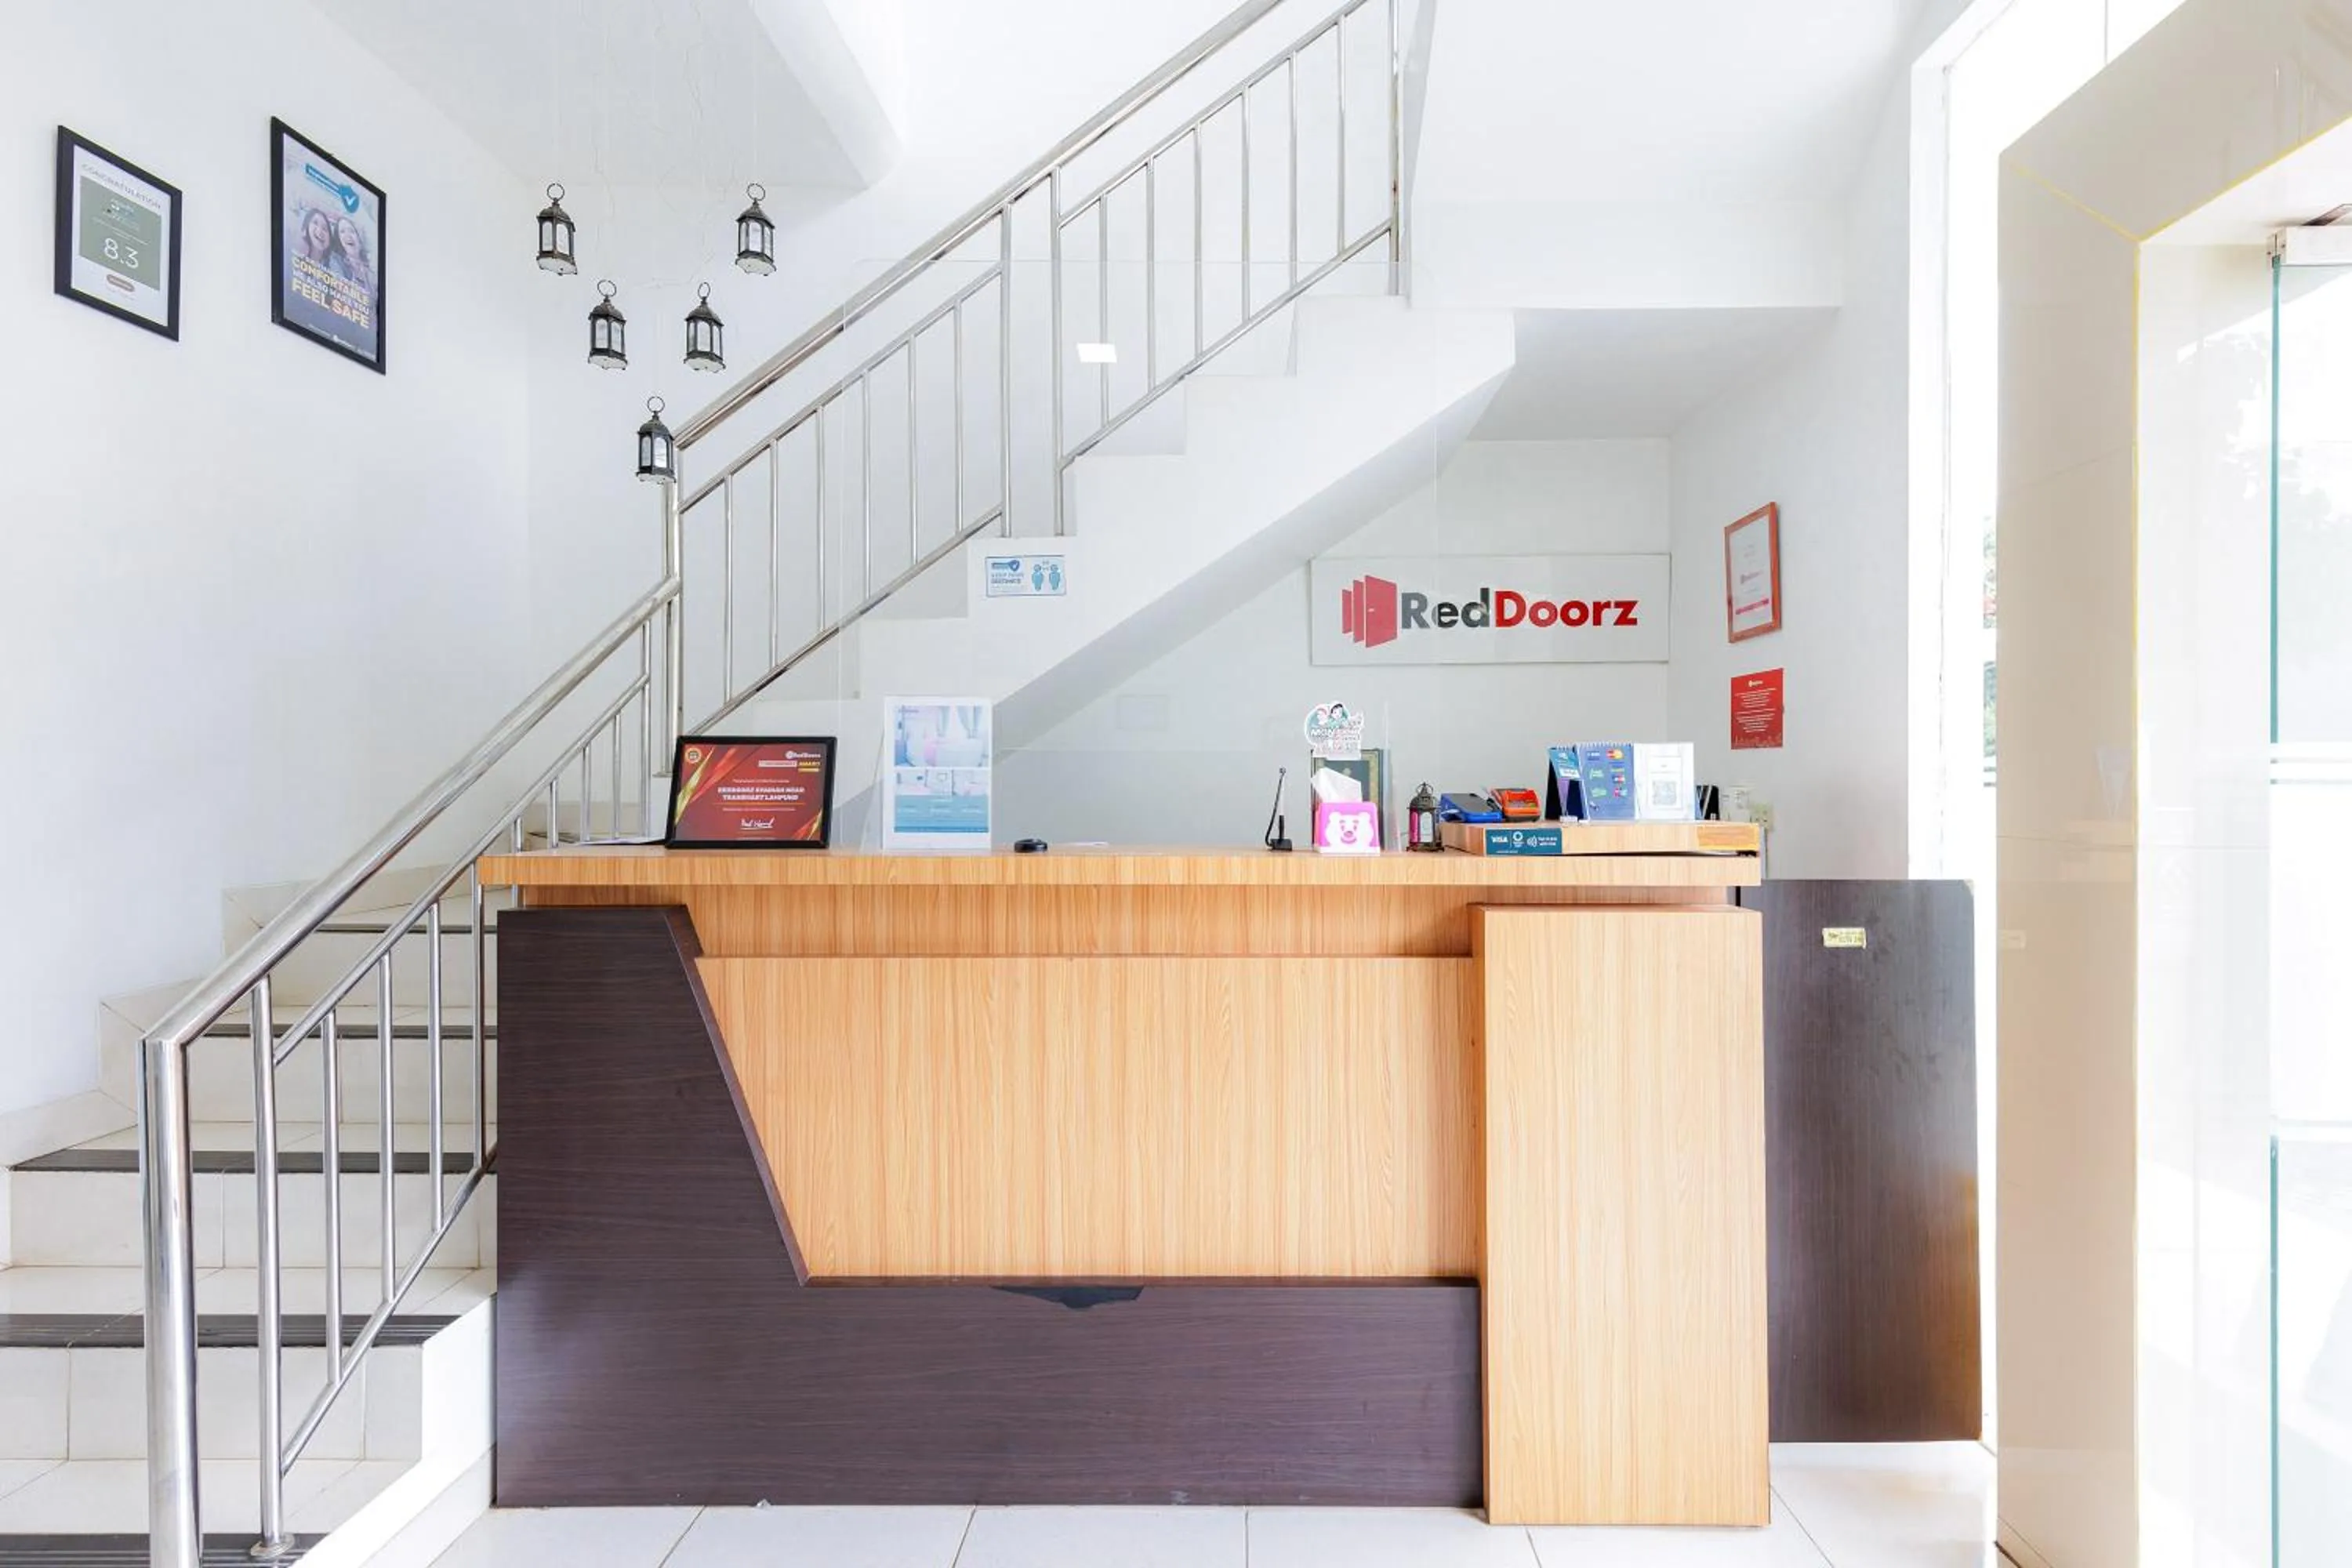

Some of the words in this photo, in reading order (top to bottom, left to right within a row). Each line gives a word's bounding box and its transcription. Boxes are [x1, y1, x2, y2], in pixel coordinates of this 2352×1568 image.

[103, 237, 139, 270] 8.3
[292, 276, 329, 309] FEEL
[332, 296, 369, 328] SAFE
[1401, 587, 1639, 629] RedDoorz
